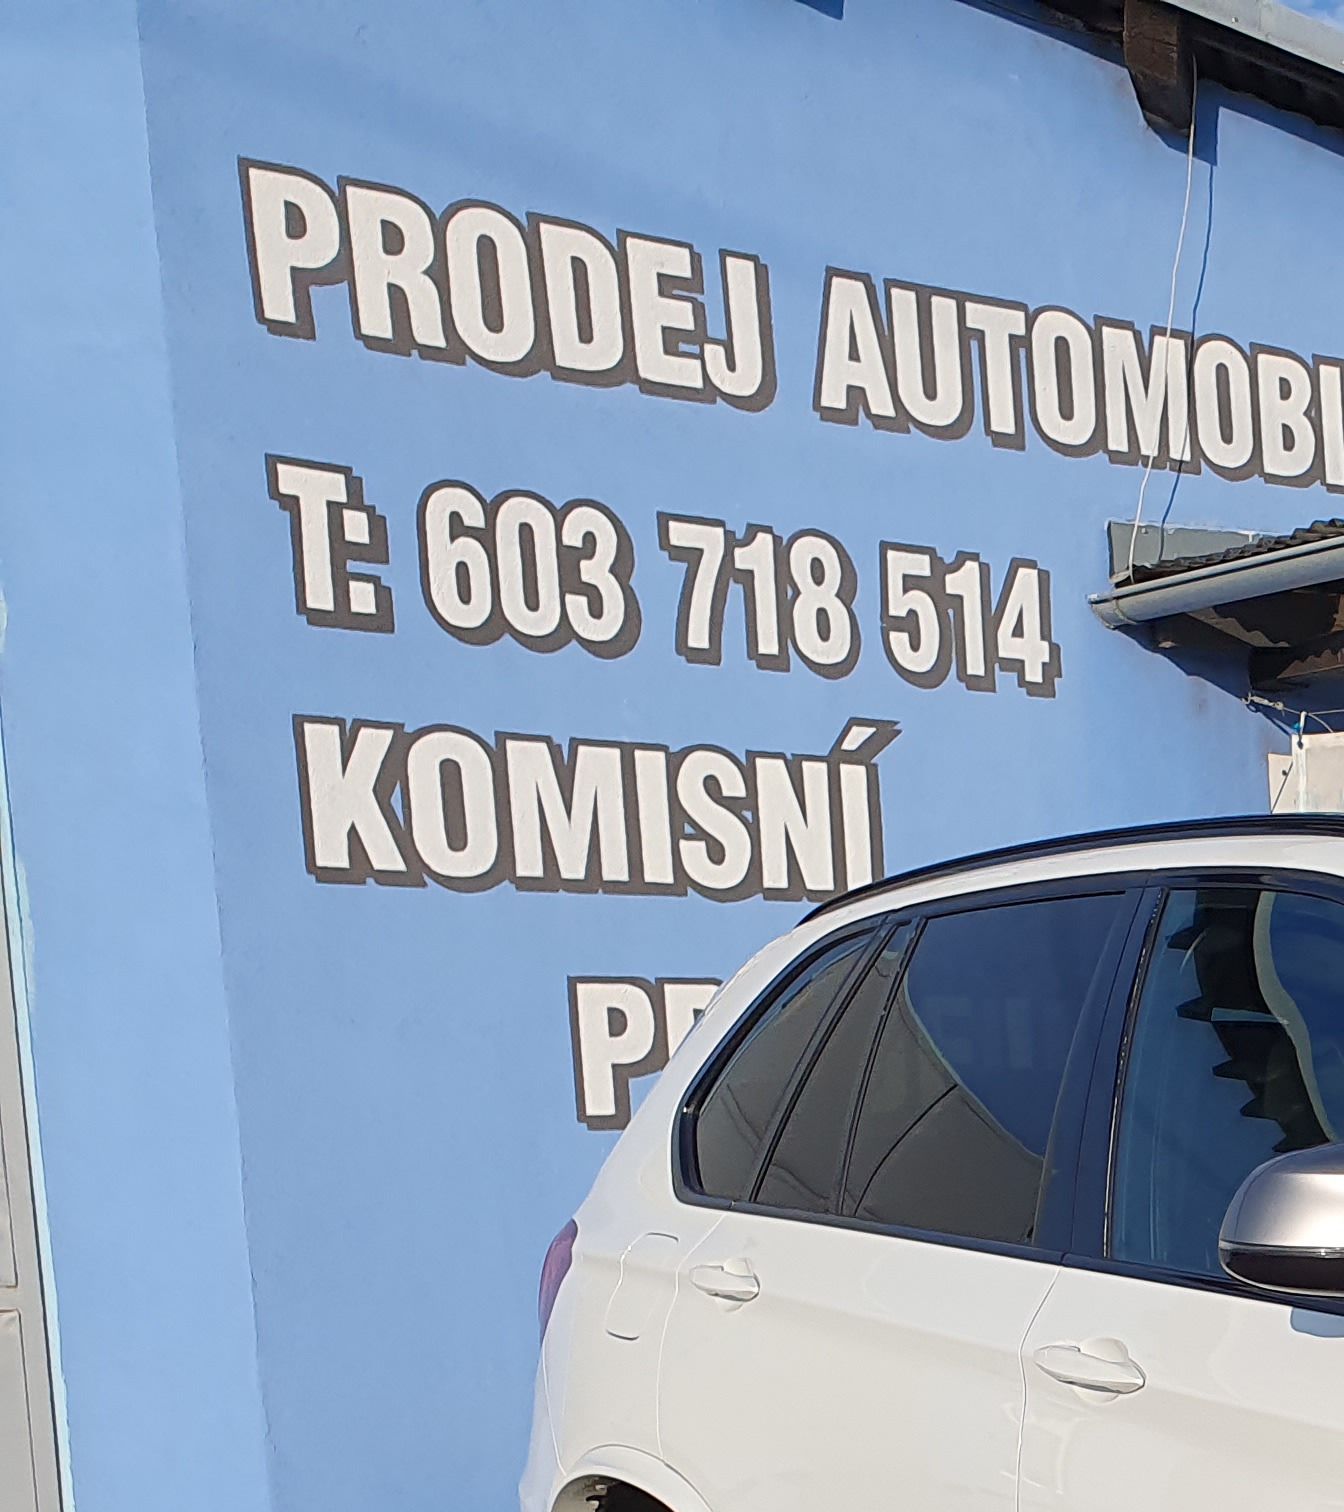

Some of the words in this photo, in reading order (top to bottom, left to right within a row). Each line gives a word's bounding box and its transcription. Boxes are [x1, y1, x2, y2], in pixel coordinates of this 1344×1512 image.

[239, 156, 777, 410] PRODEJ
[266, 453, 394, 632] T:
[418, 478, 639, 661] 603
[657, 511, 861, 680] 718
[878, 541, 1061, 698] 514
[292, 712, 901, 903] KOMISNÍ
